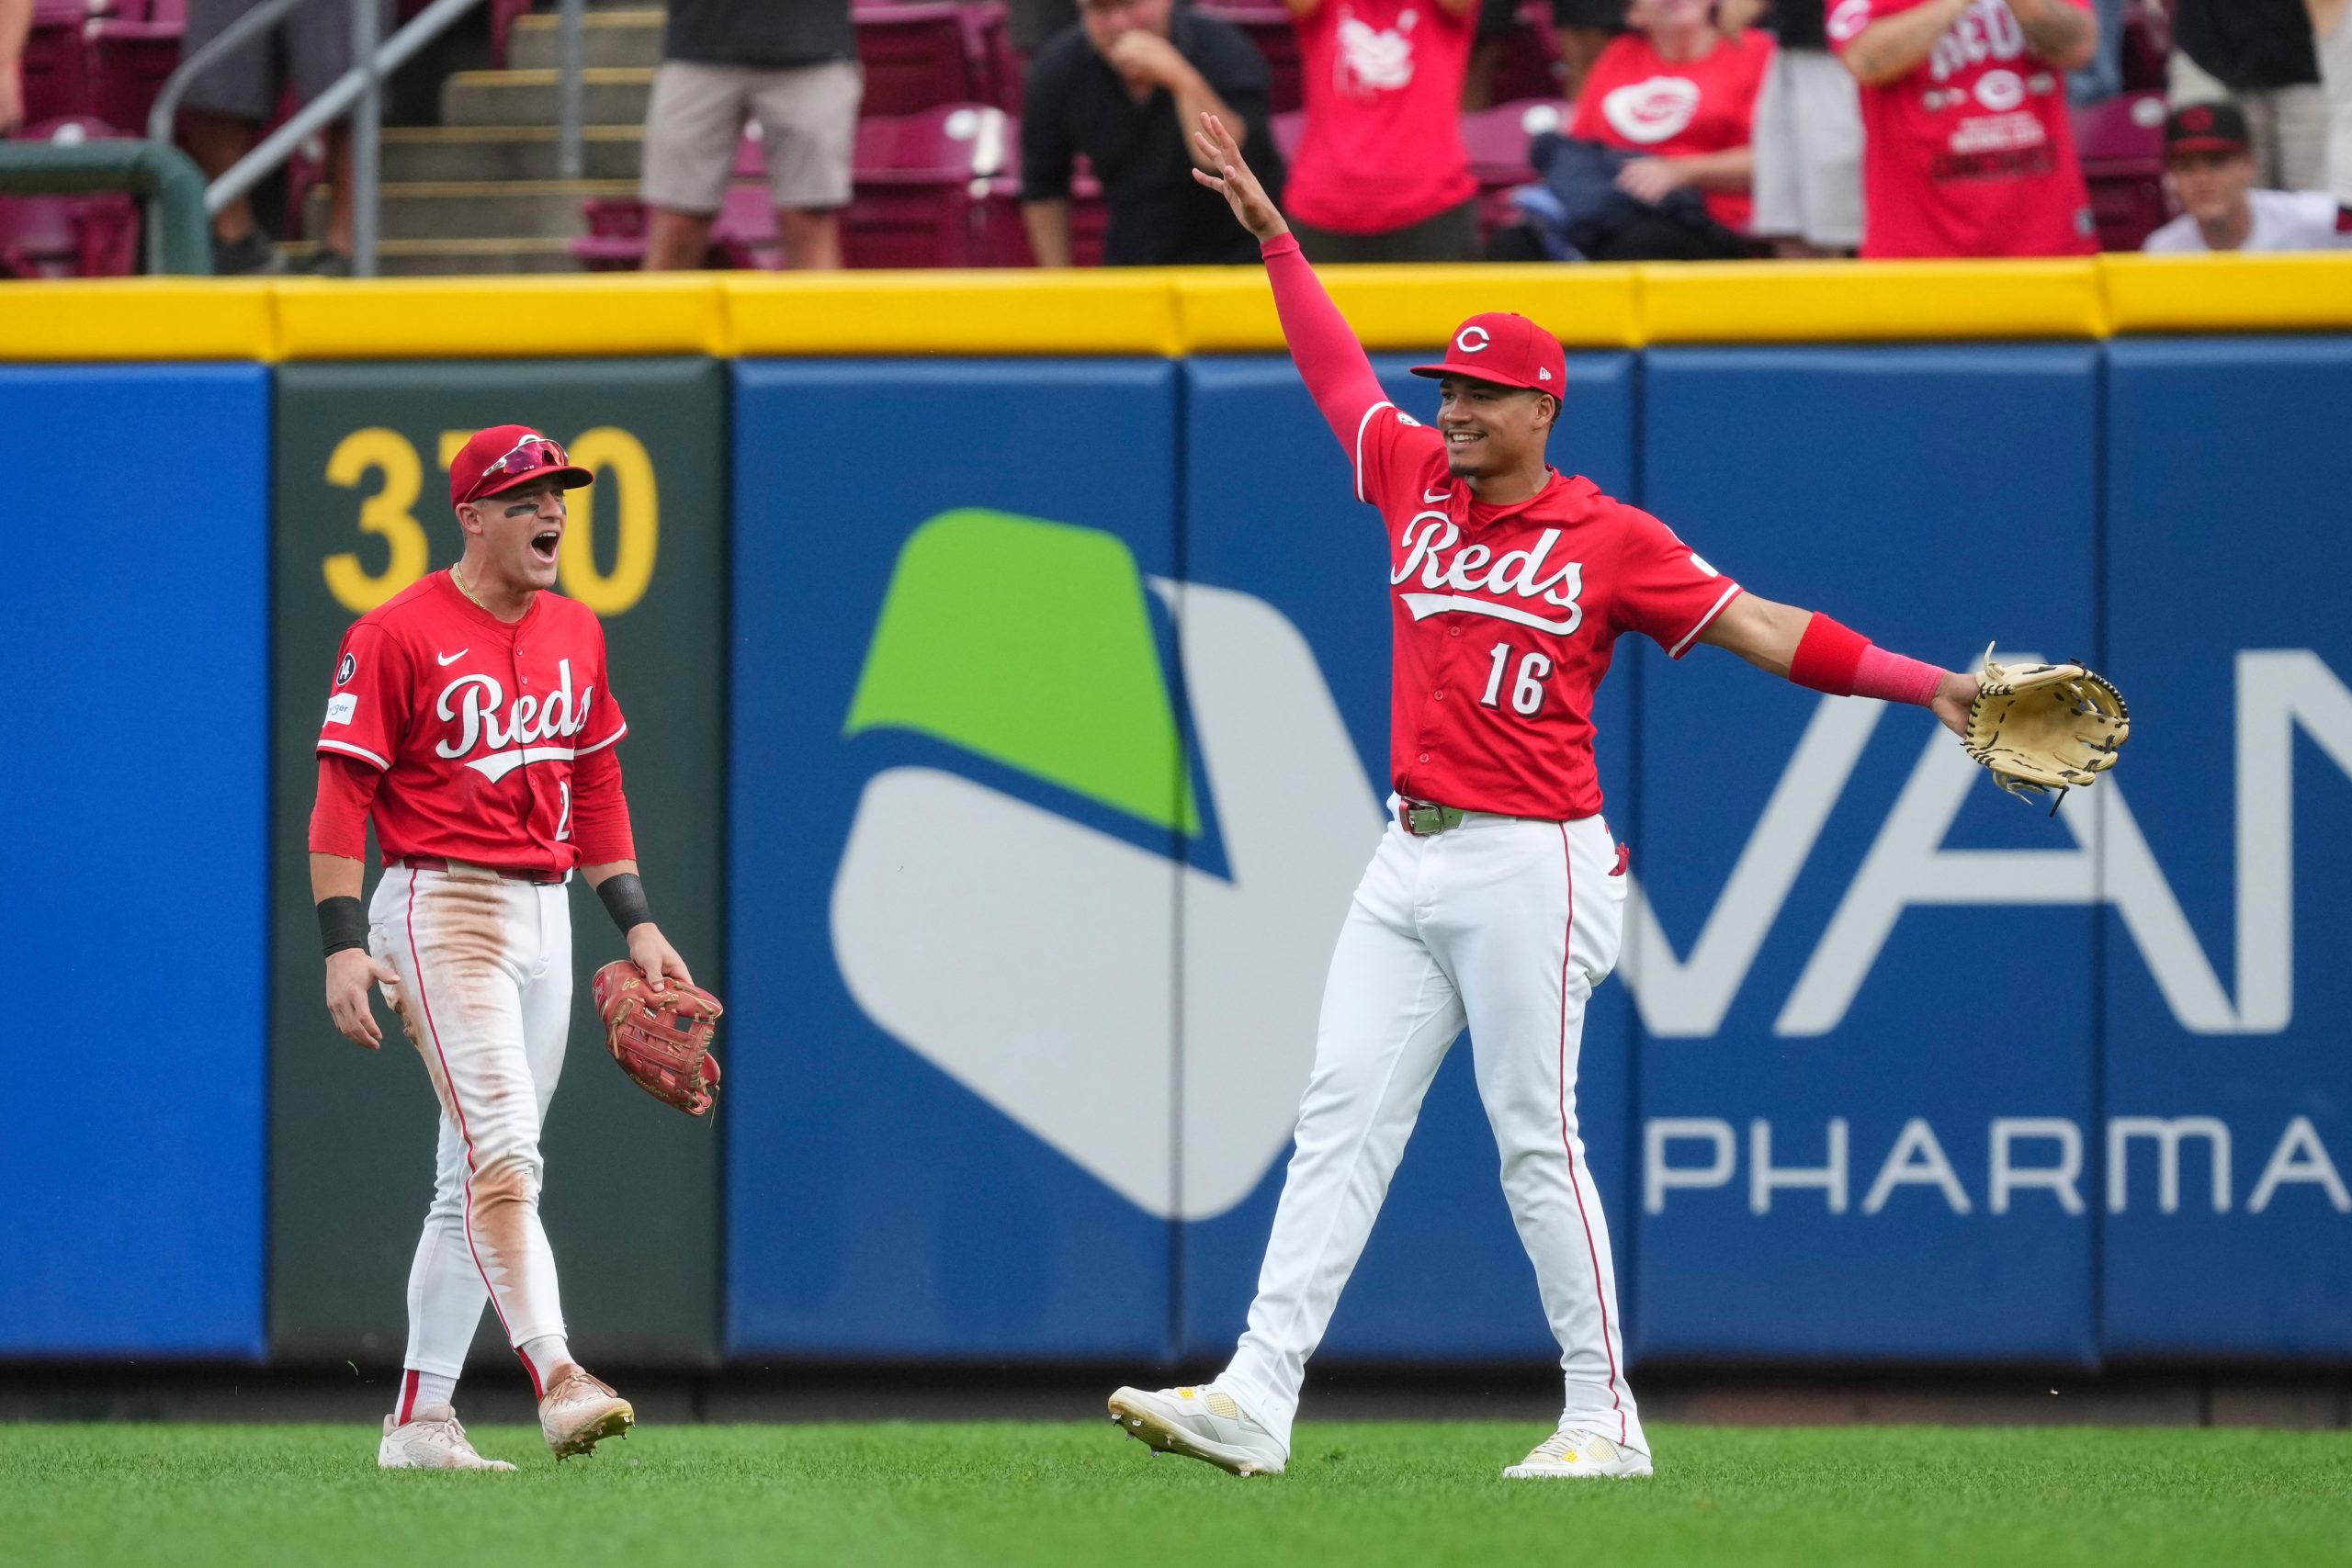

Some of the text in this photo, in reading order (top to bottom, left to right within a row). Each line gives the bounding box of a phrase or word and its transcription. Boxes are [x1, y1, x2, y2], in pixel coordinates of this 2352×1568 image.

[1456, 325, 1490, 354] C
[323, 426, 660, 617] 30
[1390, 511, 1583, 637] Reds
[435, 659, 594, 759] Reds
[1479, 642, 1555, 719] 16
[1643, 1115, 2352, 1216] PHARMA
